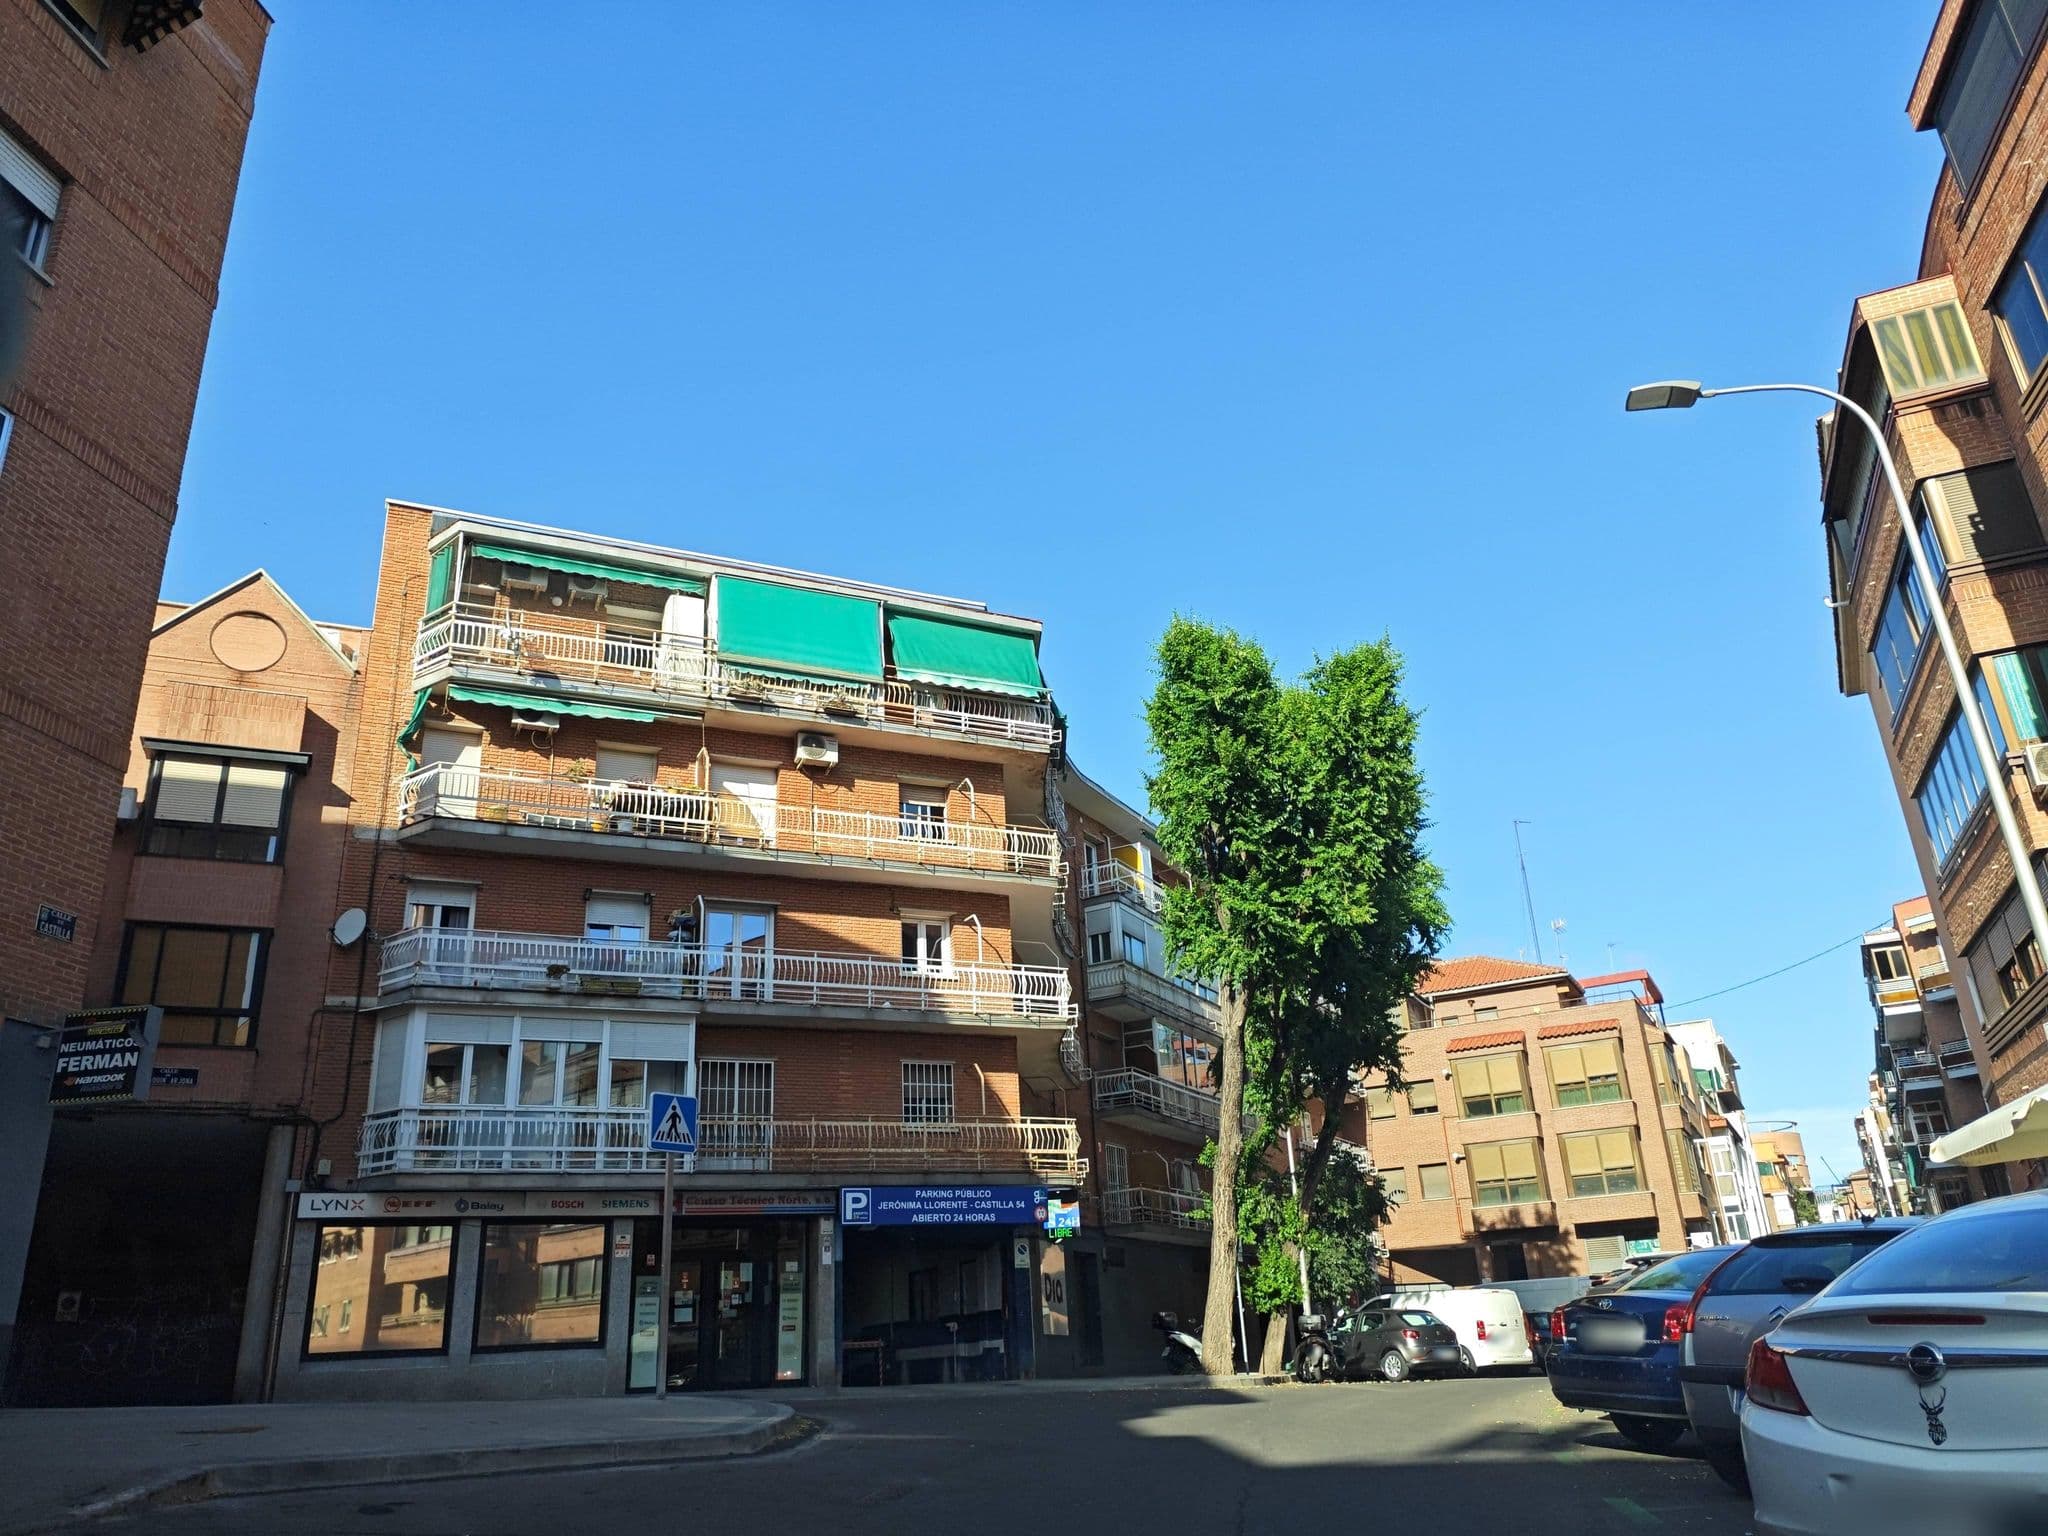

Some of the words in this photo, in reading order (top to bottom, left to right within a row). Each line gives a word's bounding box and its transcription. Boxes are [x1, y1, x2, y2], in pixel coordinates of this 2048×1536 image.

[39, 921, 71, 940] CASTILLA
[56, 1052, 139, 1073] FERMAN
[915, 1190, 954, 1199] PARKING
[955, 1188, 992, 1199] PÚBLICO
[311, 1199, 365, 1211] LYNX
[471, 1201, 504, 1212] Balay
[551, 1200, 584, 1209] BOSCH
[602, 1200, 650, 1209] SIEMENS
[846, 1193, 868, 1220] P
[877, 1200, 923, 1210] JERÓNIMA
[923, 1201, 968, 1210] LLORENTE
[974, 1200, 1015, 1209] CASTILLA
[1015, 1200, 1026, 1209] 54
[911, 1213, 952, 1223] ABIERTO
[953, 1213, 964, 1222] 24
[964, 1213, 997, 1222] HORAS
[1048, 1227, 1073, 1239] LIBRE
